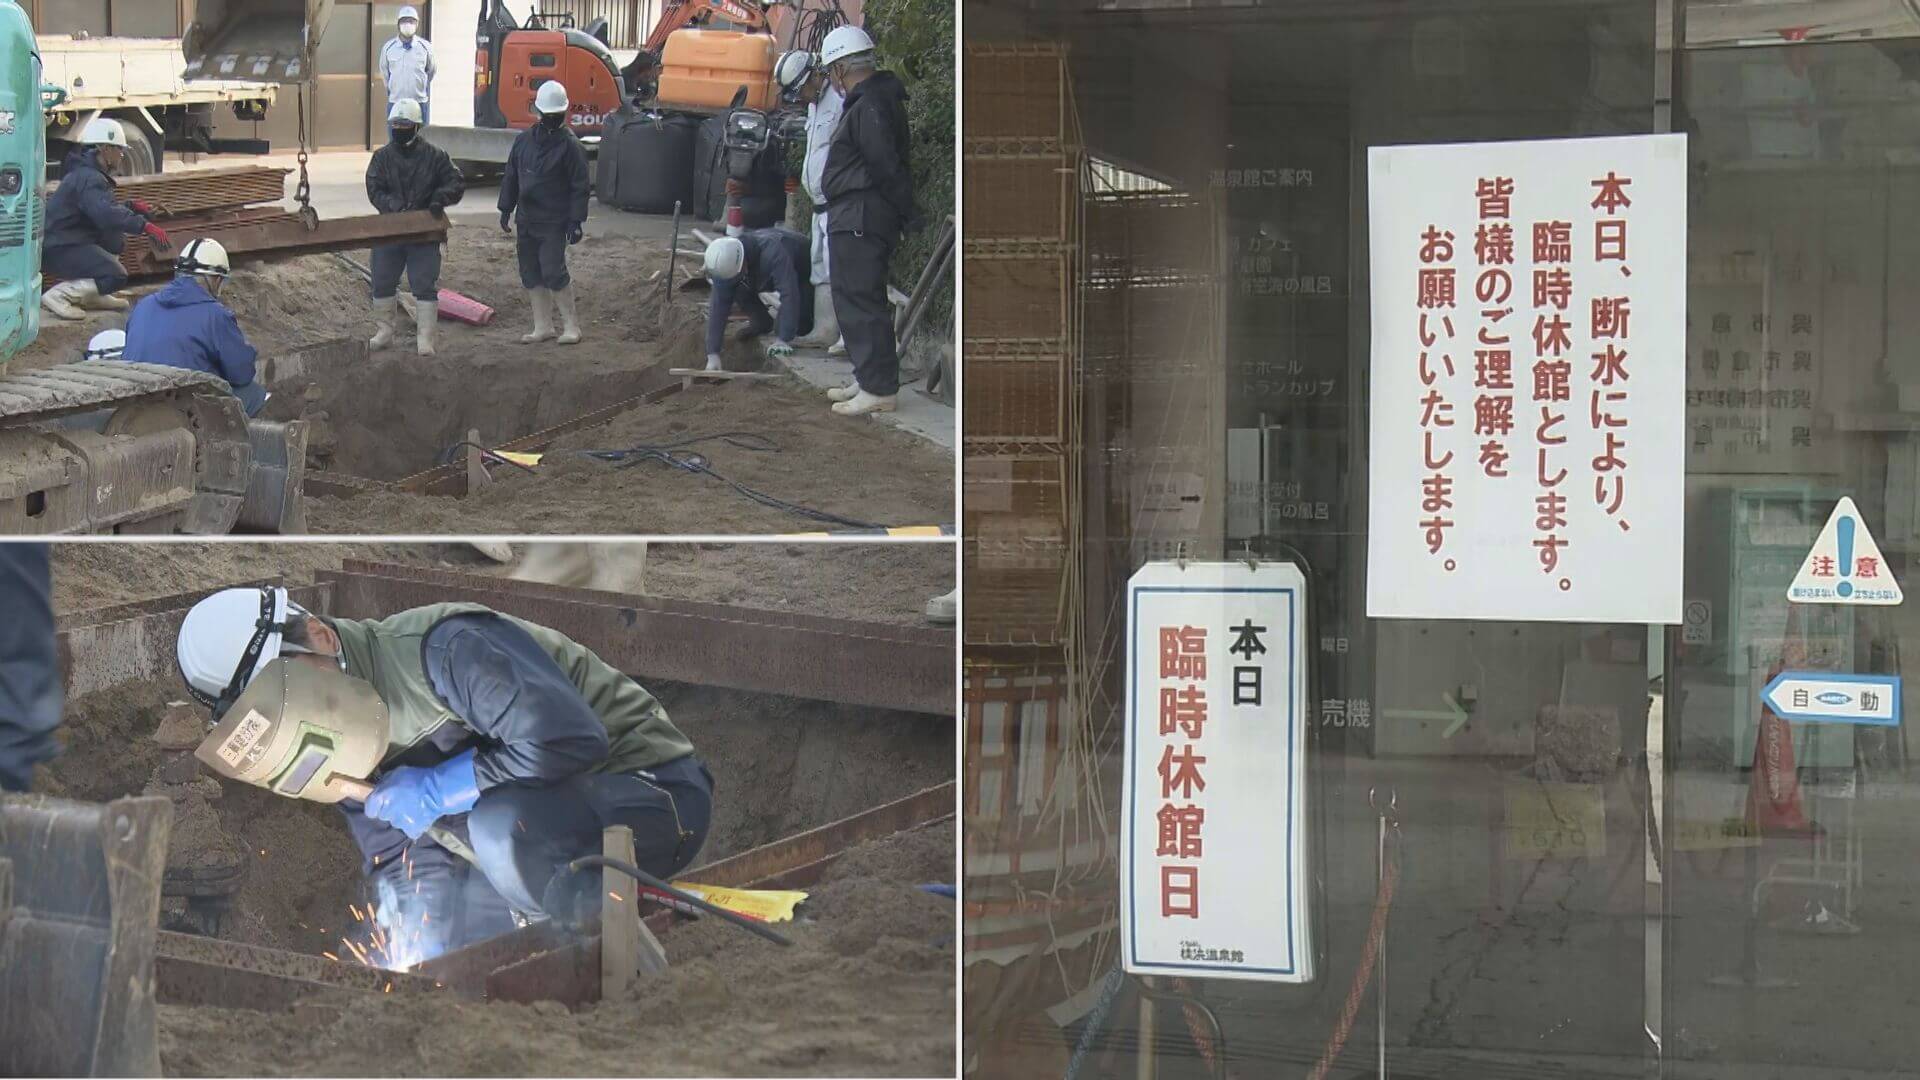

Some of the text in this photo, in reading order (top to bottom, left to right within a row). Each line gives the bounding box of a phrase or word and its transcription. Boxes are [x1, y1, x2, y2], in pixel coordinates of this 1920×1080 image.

[1416, 223, 1457, 573] お願いいたします。
[1473, 176, 1515, 478] 皆様のご理解を
[1531, 219, 1573, 592] 臨時休館とします。
[1590, 172, 1633, 532] 本日、断水により、
[1156, 624, 1208, 920] 臨時休館日
[1228, 618, 1268, 707] 本日
